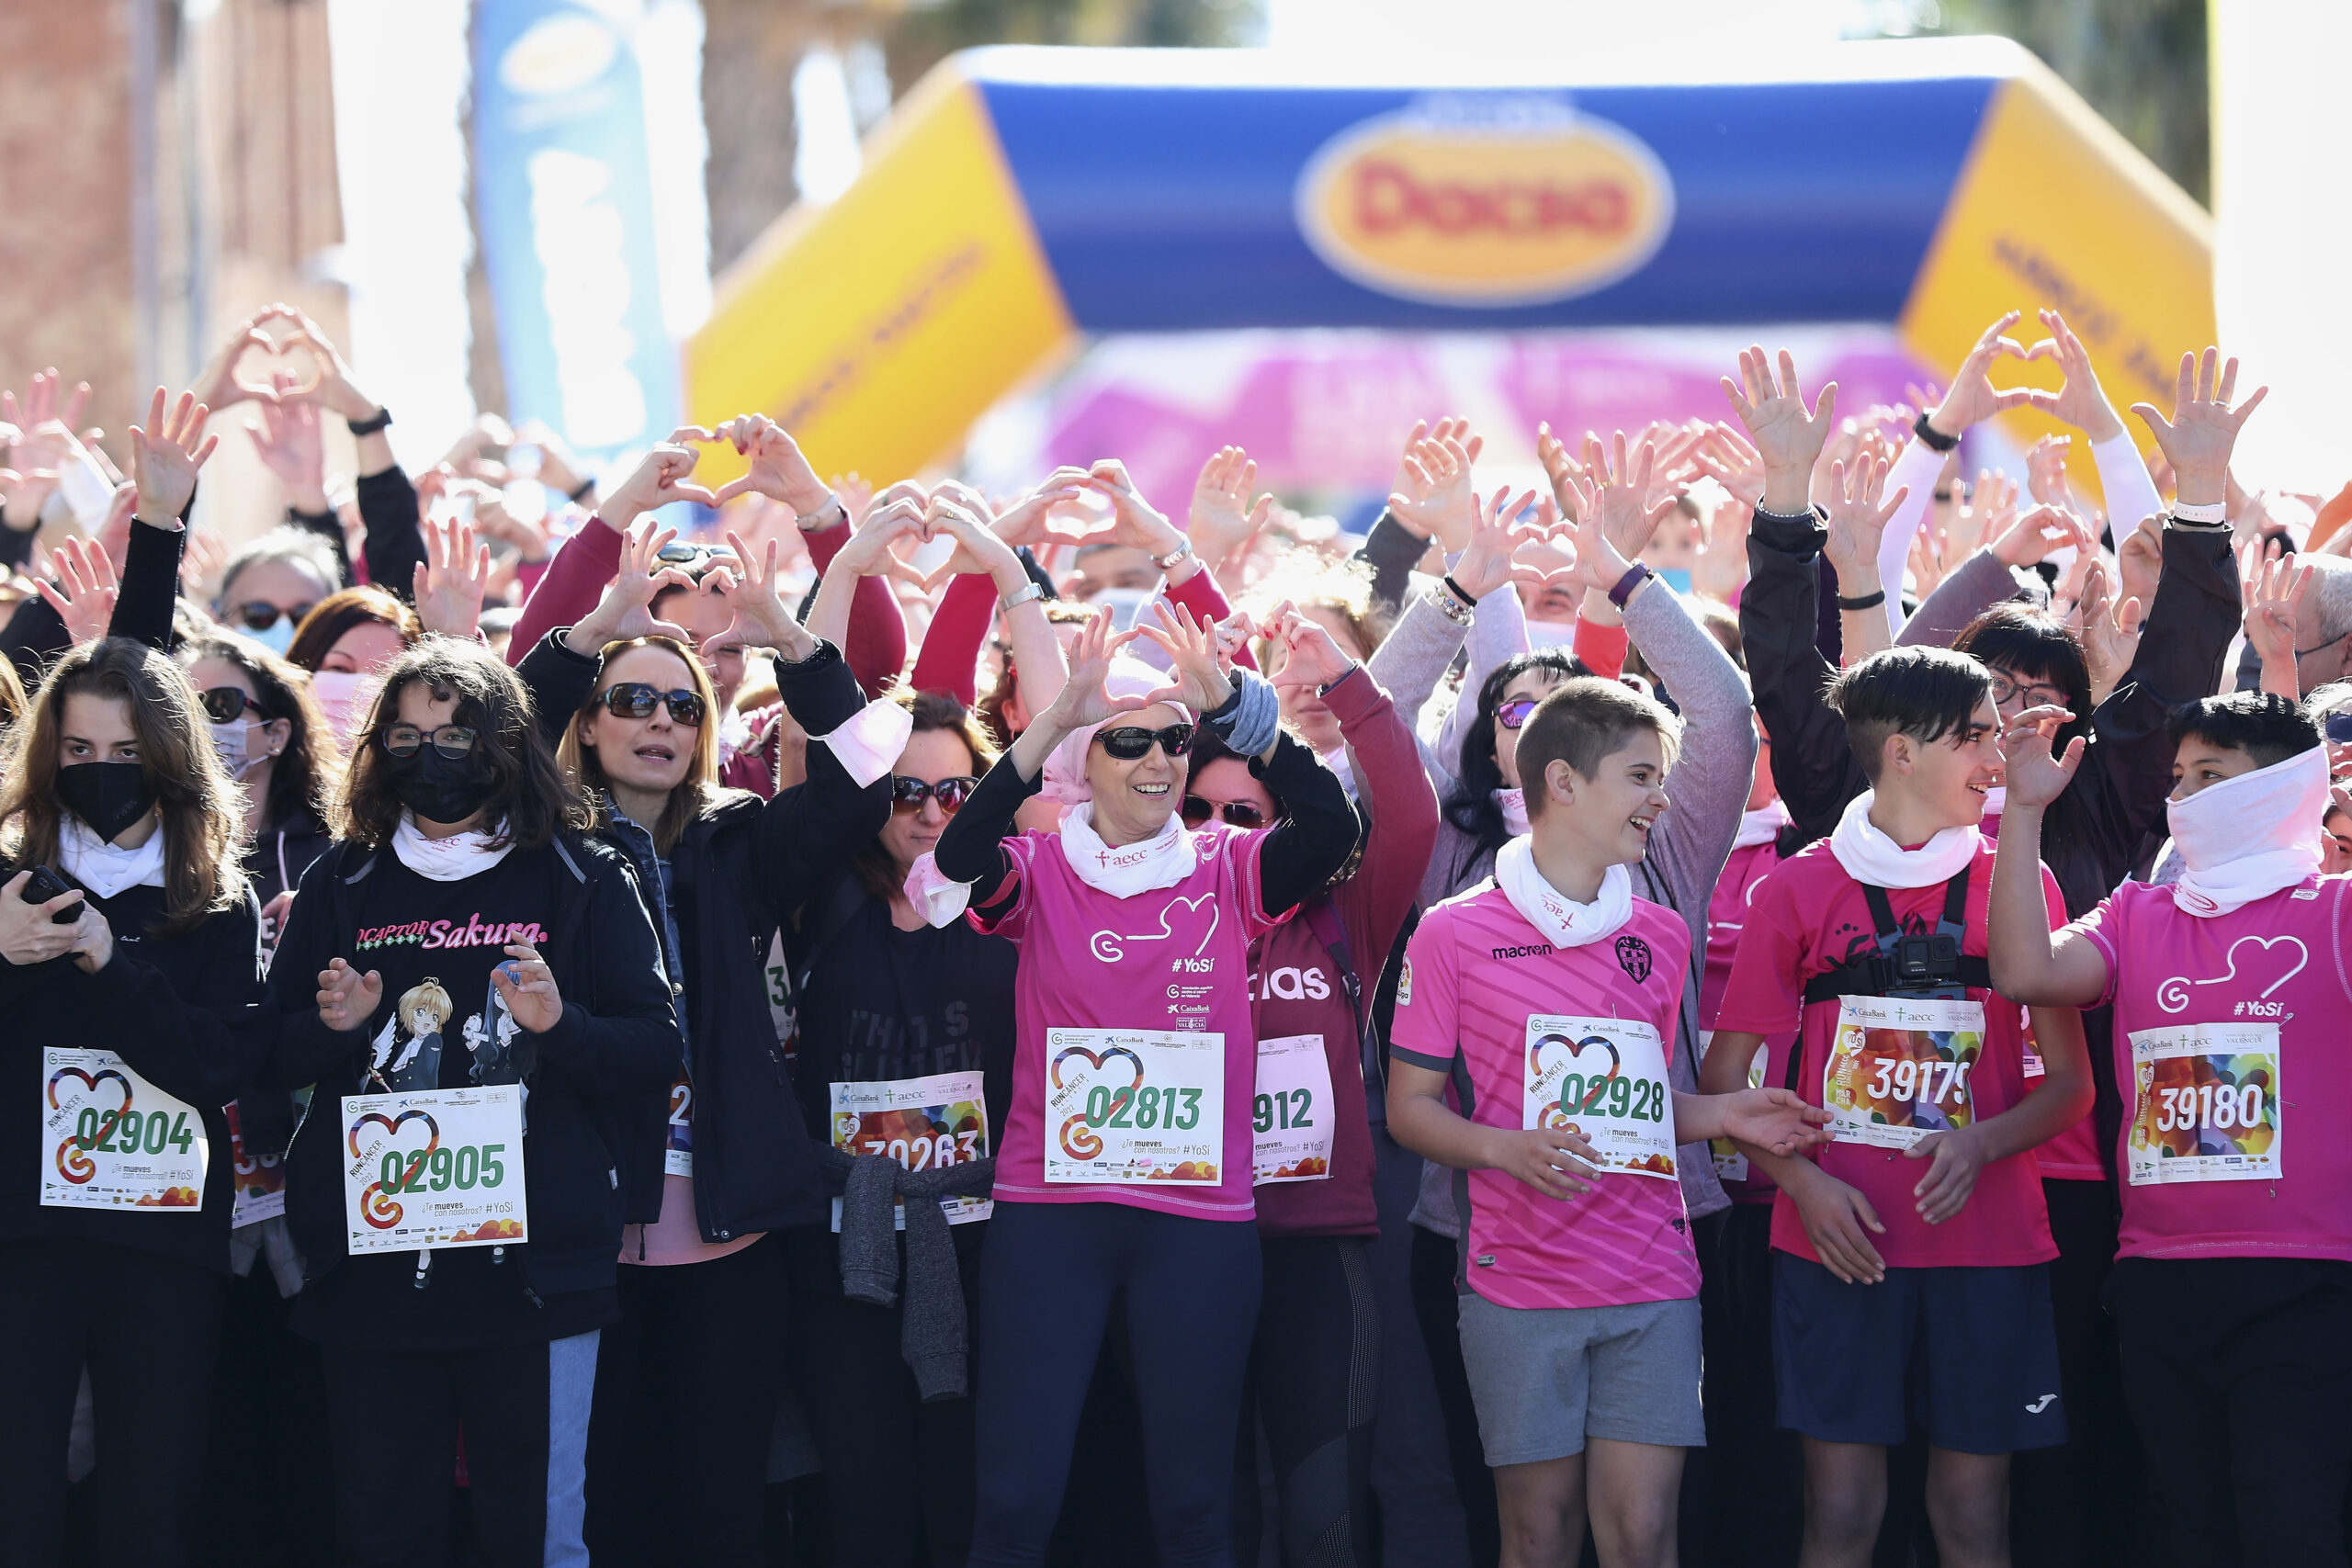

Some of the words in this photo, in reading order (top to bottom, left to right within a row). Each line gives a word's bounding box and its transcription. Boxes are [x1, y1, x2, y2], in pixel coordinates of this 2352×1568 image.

[1113, 850, 1148, 866] aecc
[1492, 943, 1552, 960] macron
[1171, 958, 1215, 973] #YoSí
[1858, 1009, 1887, 1018] CaixaBank
[2233, 1000, 2284, 1017] #YoSí
[1908, 1013, 1936, 1021] aecc
[1593, 1025, 1620, 1033] CaixaBank
[898, 1090, 926, 1100] aecc
[1539, 1090, 1554, 1104] 2022
[1560, 1073, 1665, 1123] 02928
[1060, 1105, 1075, 1117] 2022
[1085, 1086, 1203, 1130] 02813
[2156, 1083, 2264, 1132] 39180
[76, 1108, 193, 1155] 02904
[1611, 1129, 1638, 1137] mueves
[1148, 1145, 1181, 1155] nosotros?
[1255, 1141, 1283, 1150] mueves
[380, 1144, 505, 1195] 02905
[359, 1172, 374, 1186] 2022
[435, 1201, 464, 1210] mueves
[435, 1209, 447, 1217] con
[448, 1205, 482, 1216] nosotros?
[486, 1201, 514, 1213] #YoSí
